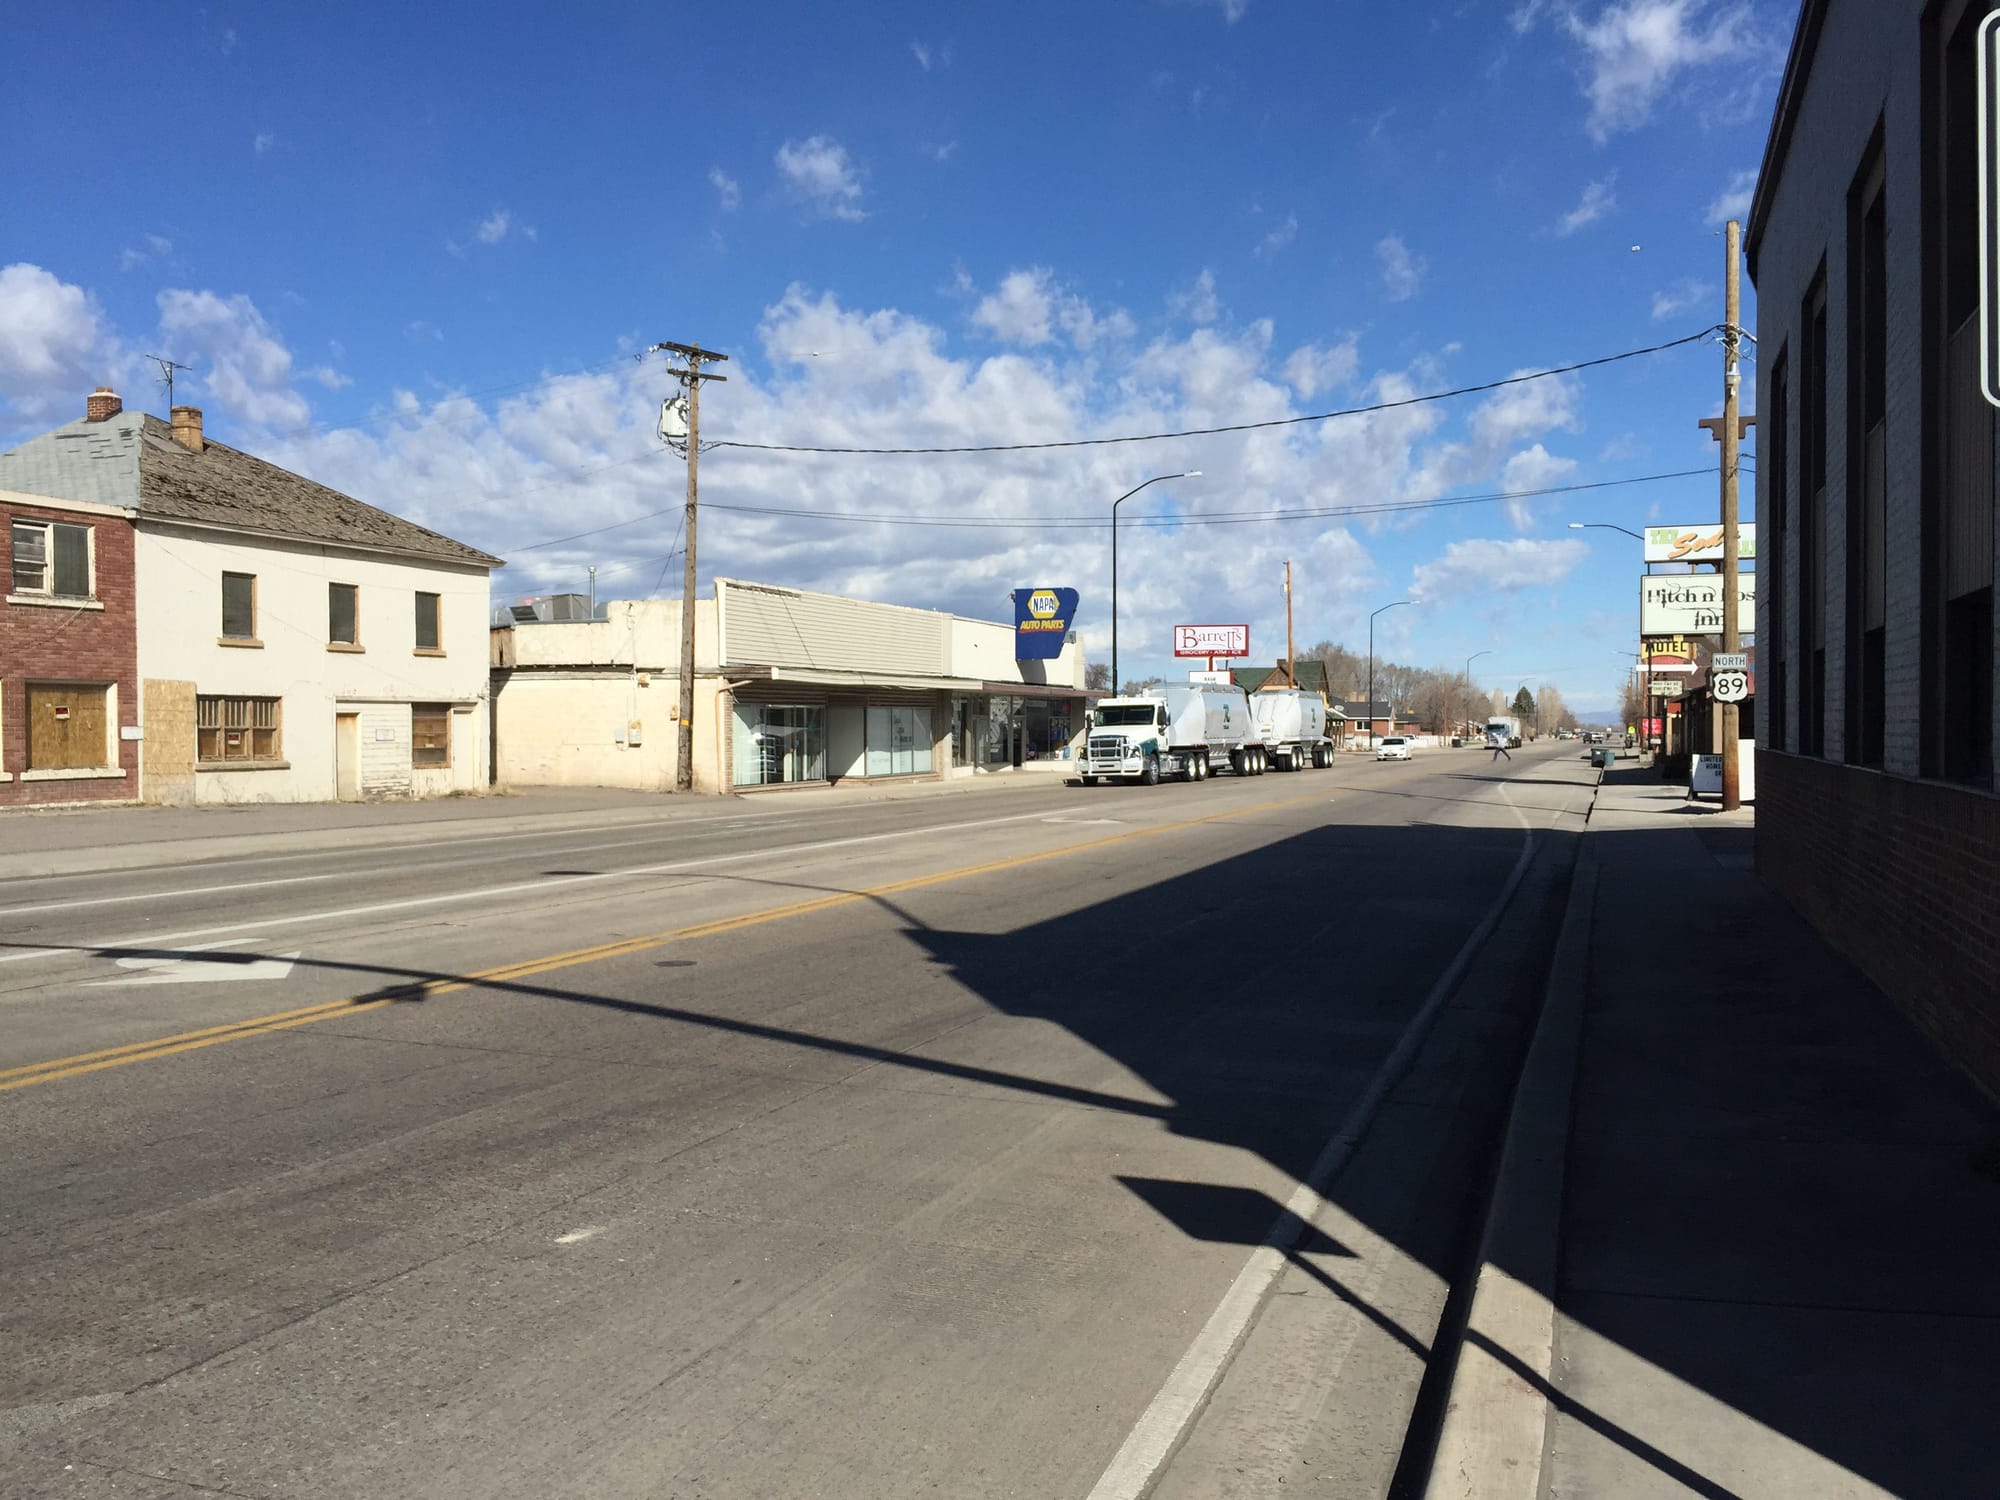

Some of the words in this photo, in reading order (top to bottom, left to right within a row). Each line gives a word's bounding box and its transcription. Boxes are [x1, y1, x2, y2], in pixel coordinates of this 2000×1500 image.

[1033, 597, 1055, 612] NAPA
[1647, 588, 1698, 609] Hitch
[1020, 620, 1040, 630] AUTO
[1041, 619, 1065, 629] PARTS
[1715, 656, 1745, 666] NORTH
[1718, 678, 1743, 695] 89
